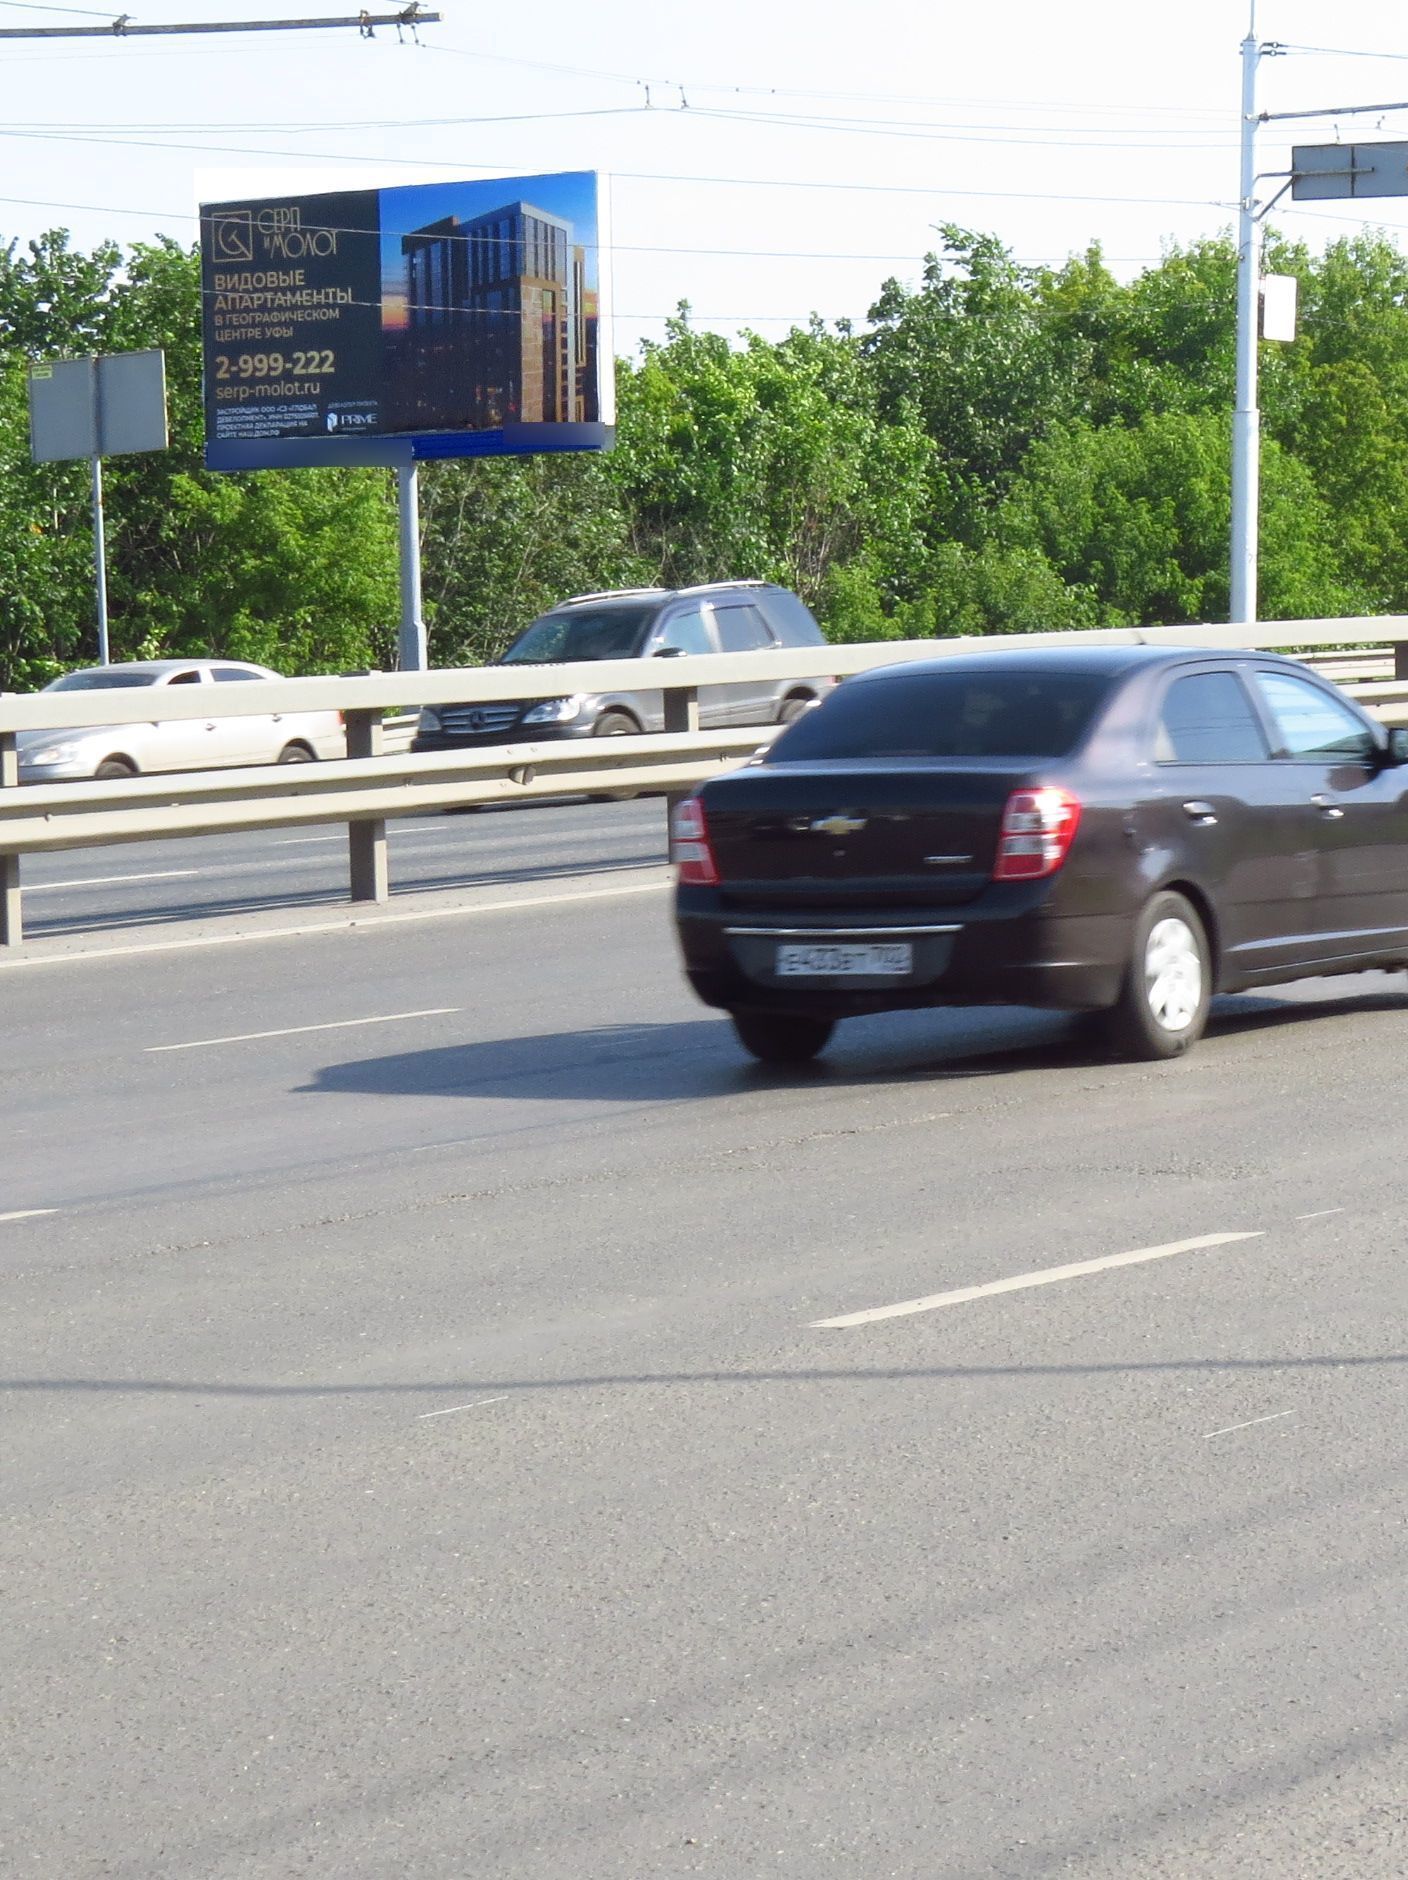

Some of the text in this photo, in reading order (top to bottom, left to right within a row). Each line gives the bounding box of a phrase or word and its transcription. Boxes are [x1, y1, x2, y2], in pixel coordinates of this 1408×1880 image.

[258, 207, 301, 234] СЕРП
[270, 231, 338, 259] МОЛОТ
[214, 270, 305, 292] ВИДОВЫЕ
[214, 287, 352, 311] АПАРТАМЕНТЫ
[214, 308, 340, 326] В ГЕОГРАФИЧЕСКОМ
[215, 326, 293, 343] ЦЕНТРЕ УФЫ
[215, 350, 335, 379] 2-999-222
[216, 380, 320, 401] serp-molot.ru
